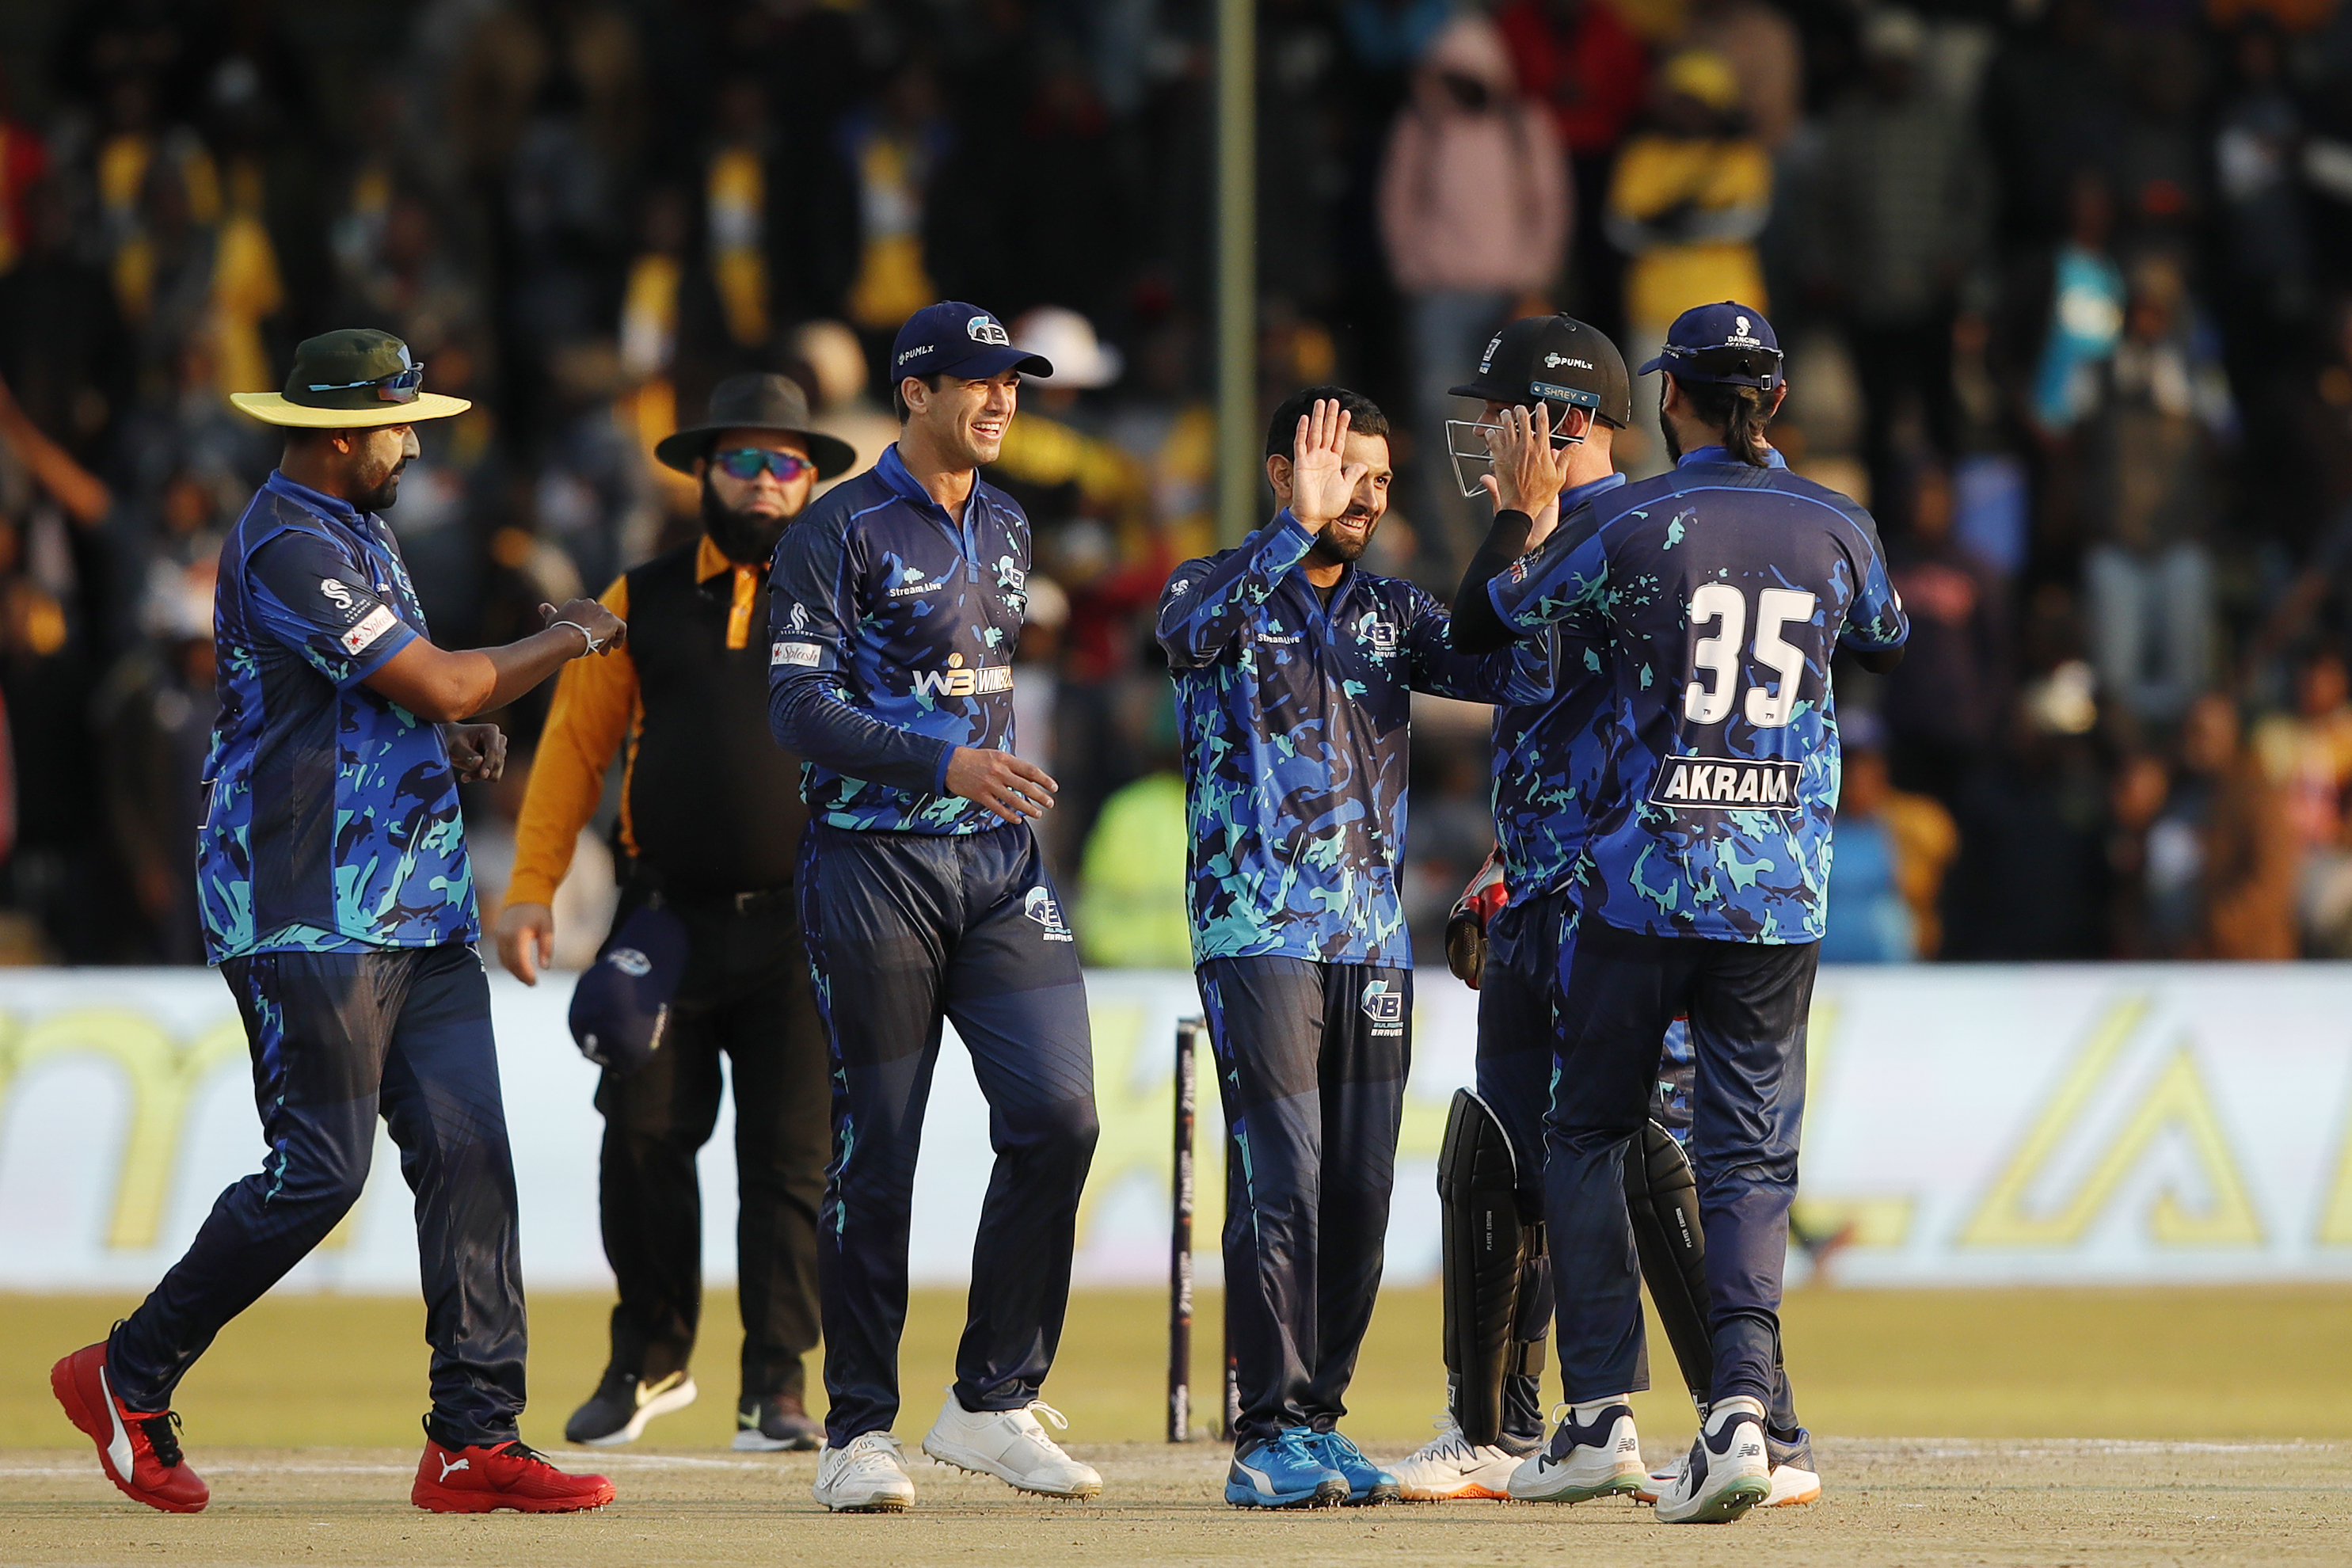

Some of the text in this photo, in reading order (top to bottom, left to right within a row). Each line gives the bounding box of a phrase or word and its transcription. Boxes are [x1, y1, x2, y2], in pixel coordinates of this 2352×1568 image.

[1727, 336, 1760, 345] DANCING
[1543, 387, 1578, 401] SHREY
[890, 582, 942, 597] Stream Live
[361, 610, 393, 637] Splash
[784, 645, 819, 663] Splash
[1684, 584, 1816, 728] 35
[1664, 764, 1789, 803] AKRAM
[1371, 1029, 1403, 1037] BRAVES
